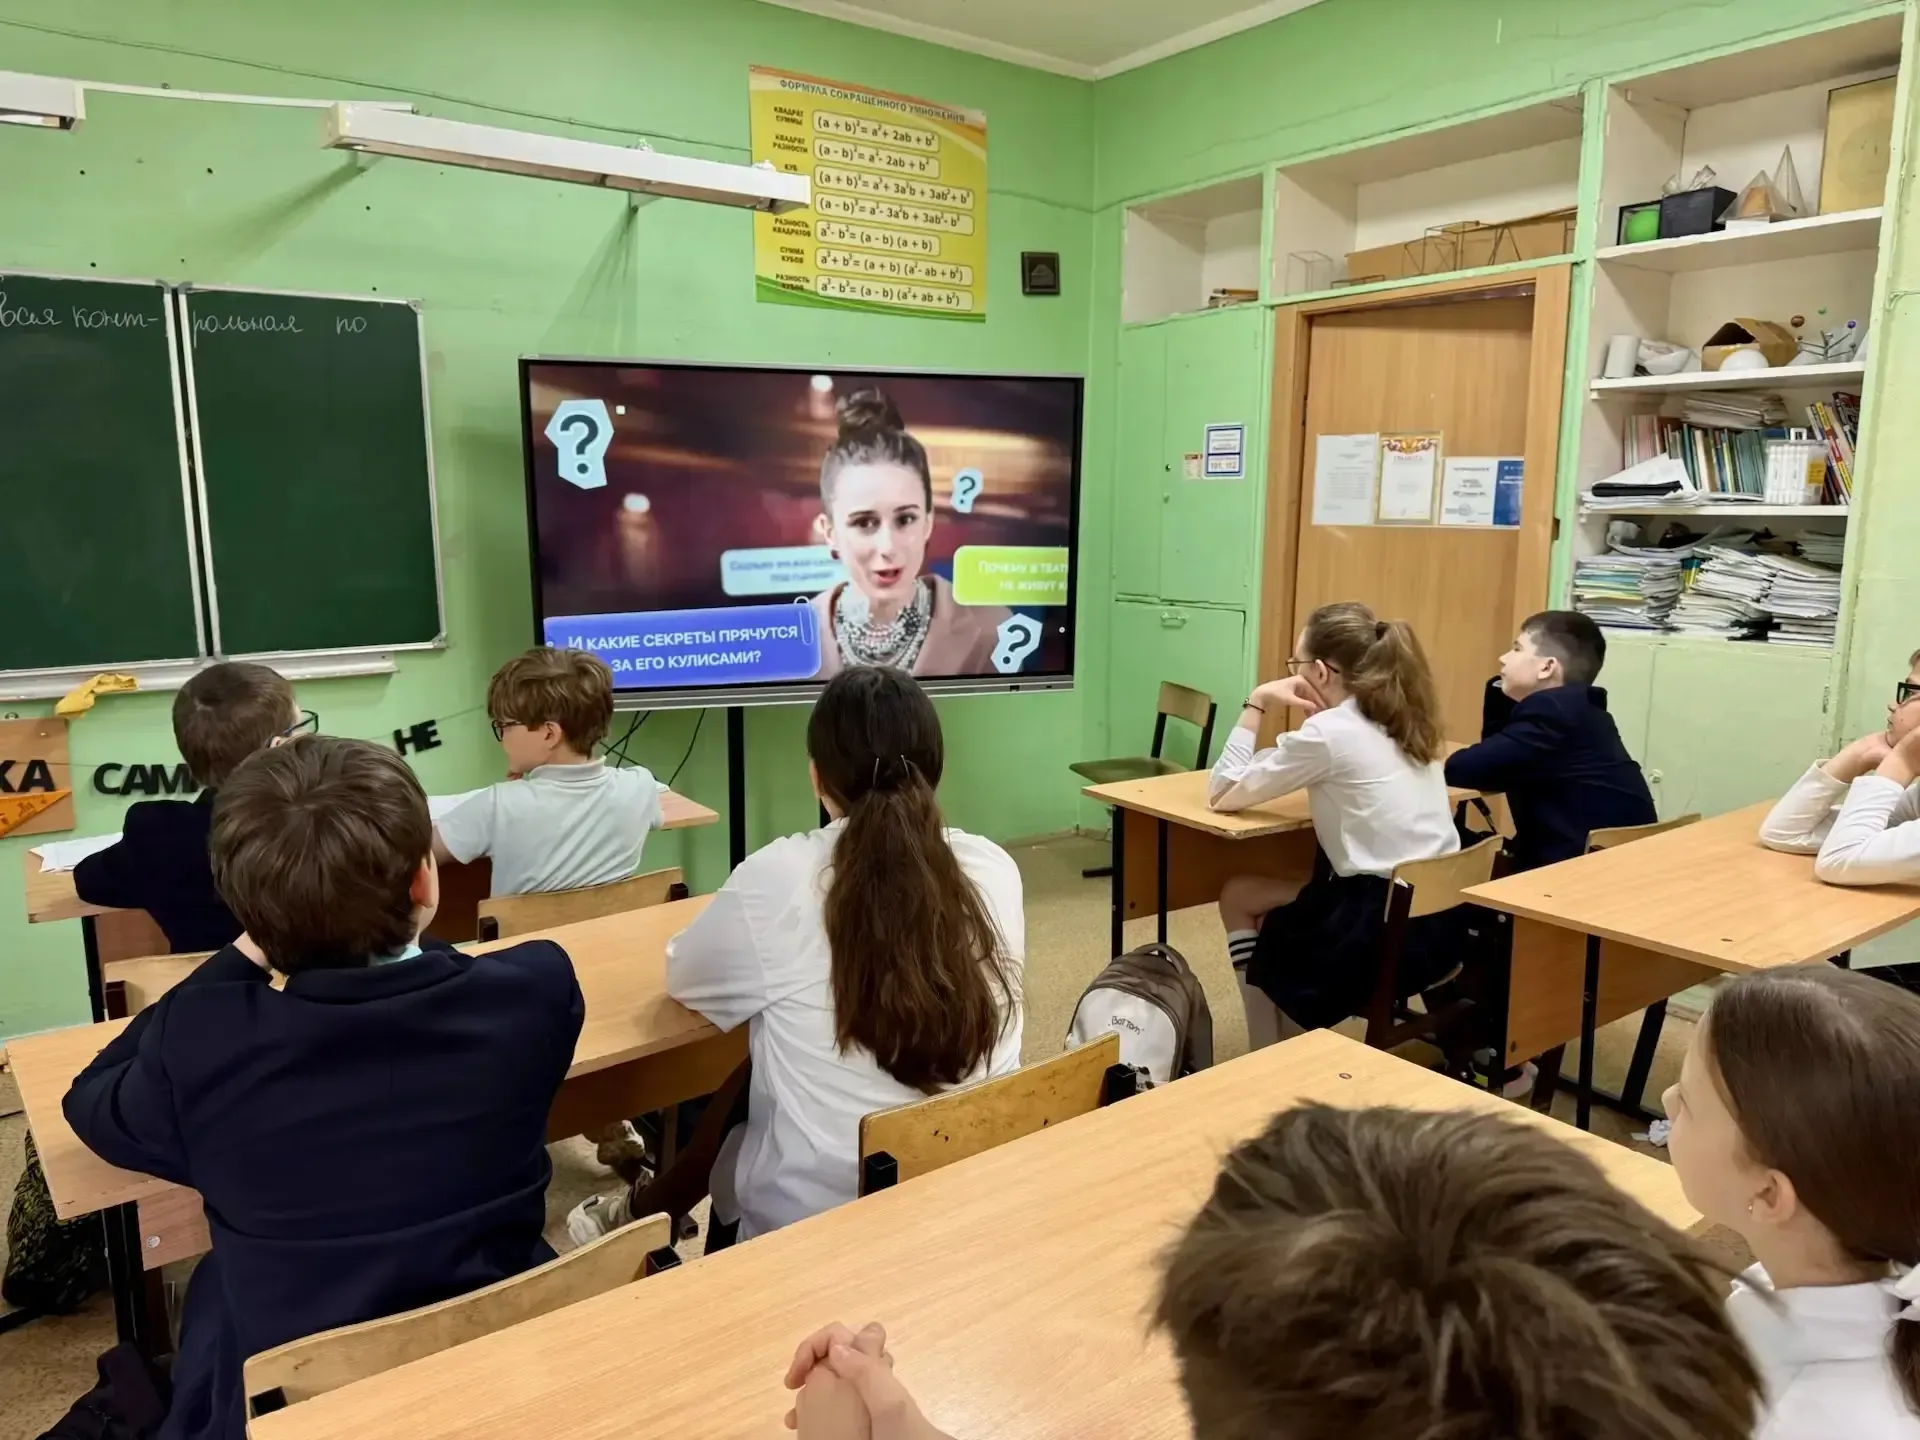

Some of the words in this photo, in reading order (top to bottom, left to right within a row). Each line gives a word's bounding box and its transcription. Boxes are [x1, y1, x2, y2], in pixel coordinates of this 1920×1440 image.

[780, 79, 828, 96] ФОРМУЛА
[830, 89, 906, 111] СОКРАЩЕННОГО
[908, 104, 965, 122] УМНОЖЕНИЯ
[336, 315, 368, 335] по
[568, 635, 583, 651] И
[586, 634, 640, 652] КАКИЕ
[642, 630, 716, 648] СЕКРЕТЫ
[719, 625, 798, 643] ПРЯЧУТСЯ
[611, 658, 632, 673] ЗА
[636, 656, 665, 671] ЕГО
[668, 651, 761, 669] КУЛИСАМИ?
[394, 719, 442, 756] НЕ
[94, 762, 198, 795] САМ
